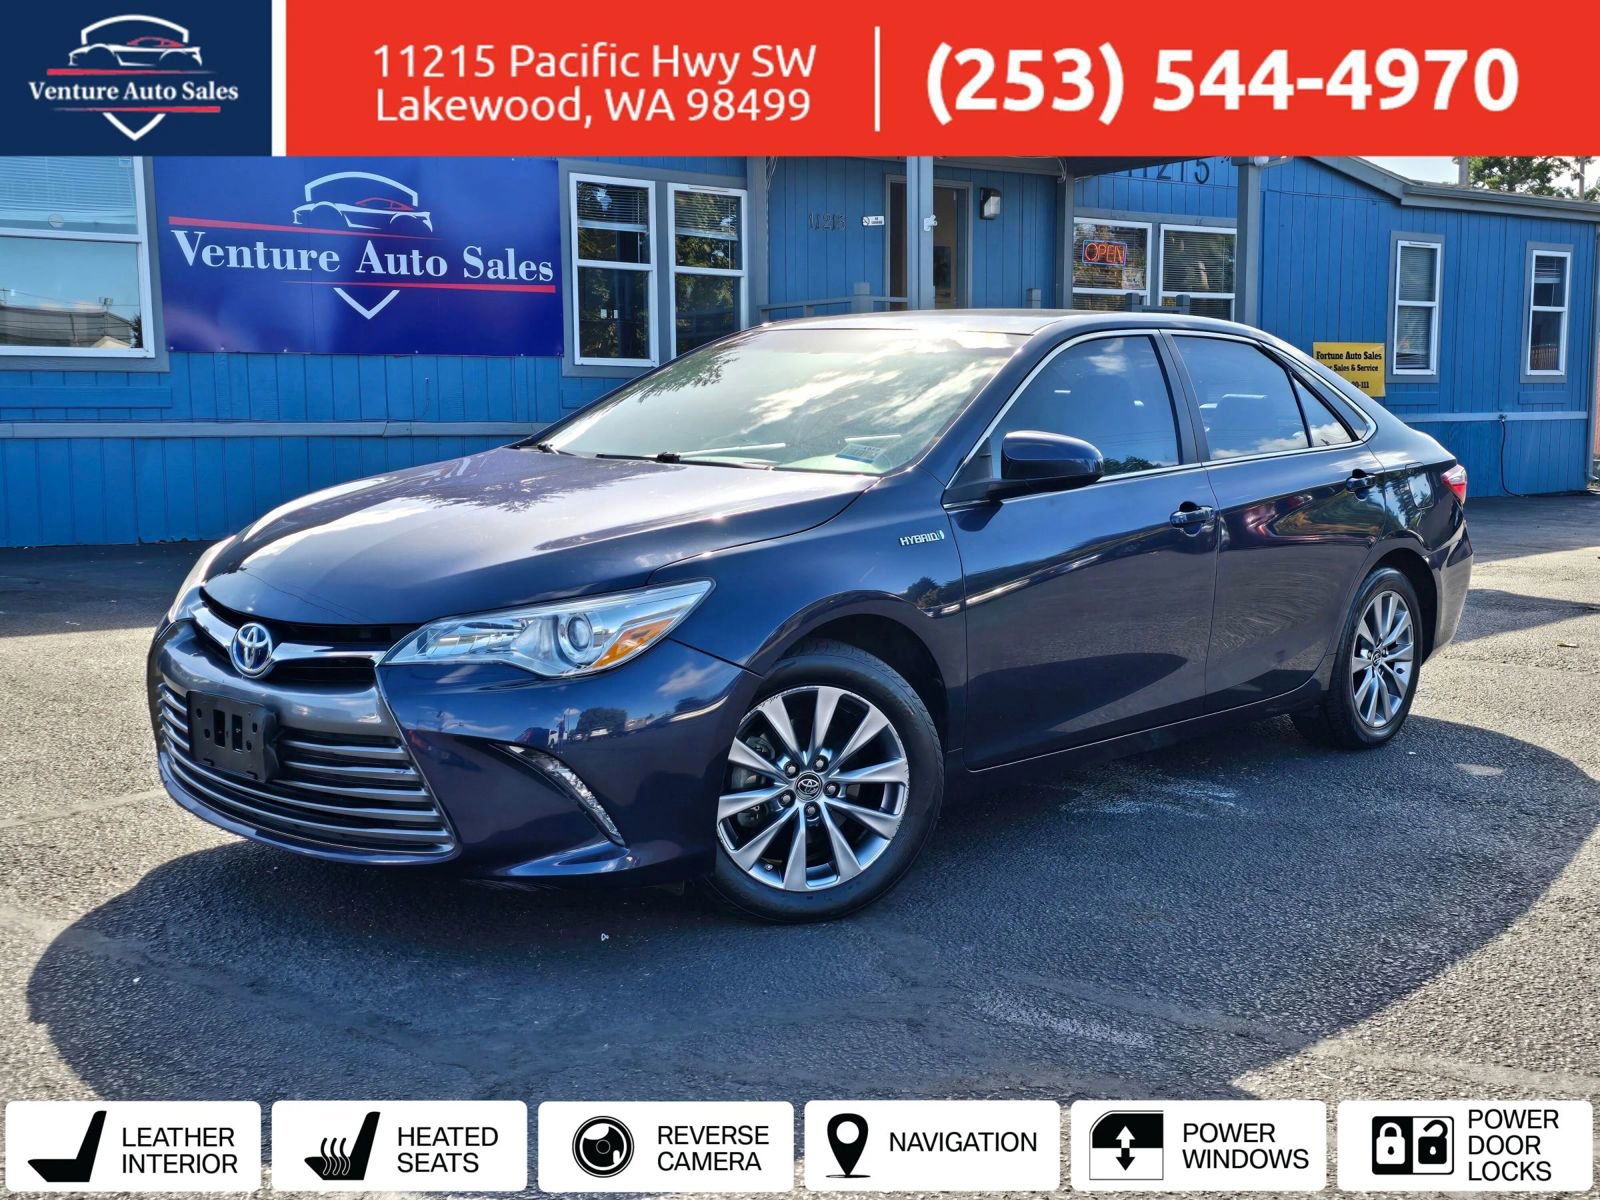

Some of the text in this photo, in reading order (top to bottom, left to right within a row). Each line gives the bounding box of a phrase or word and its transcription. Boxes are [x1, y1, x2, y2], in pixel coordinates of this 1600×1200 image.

[170, 229, 554, 282] Venture Auto Sales
[1085, 242, 1124, 264] OPEN
[1316, 351, 1382, 360] Fortune Auto Sales
[900, 532, 938, 546] HYBRID
